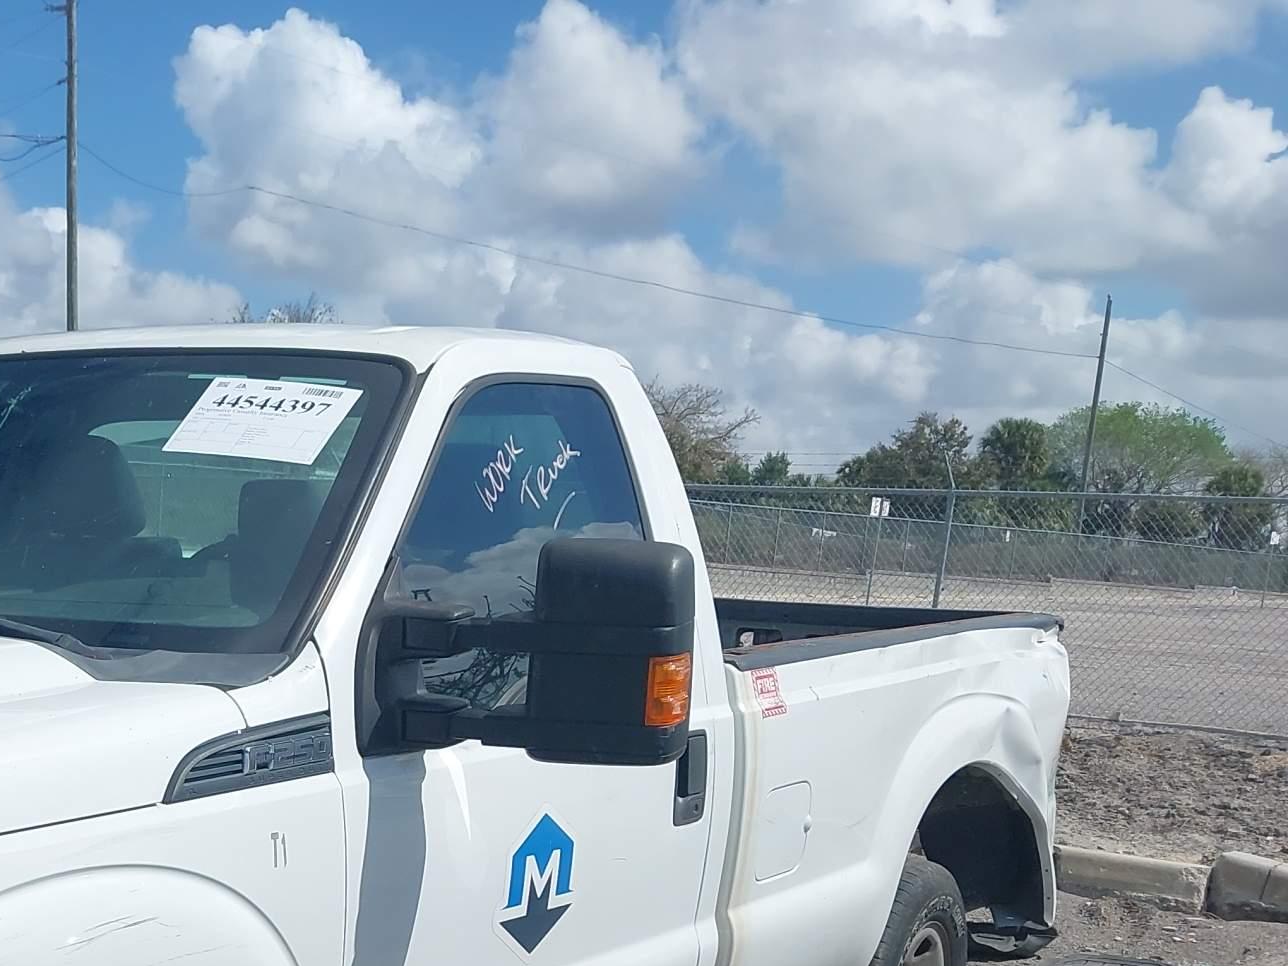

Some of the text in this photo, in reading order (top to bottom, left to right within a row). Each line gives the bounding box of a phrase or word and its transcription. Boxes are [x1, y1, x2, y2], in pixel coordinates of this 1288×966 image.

[212, 394, 333, 417] 44544397
[474, 434, 524, 512] WORK
[757, 677, 777, 693] FIRE
